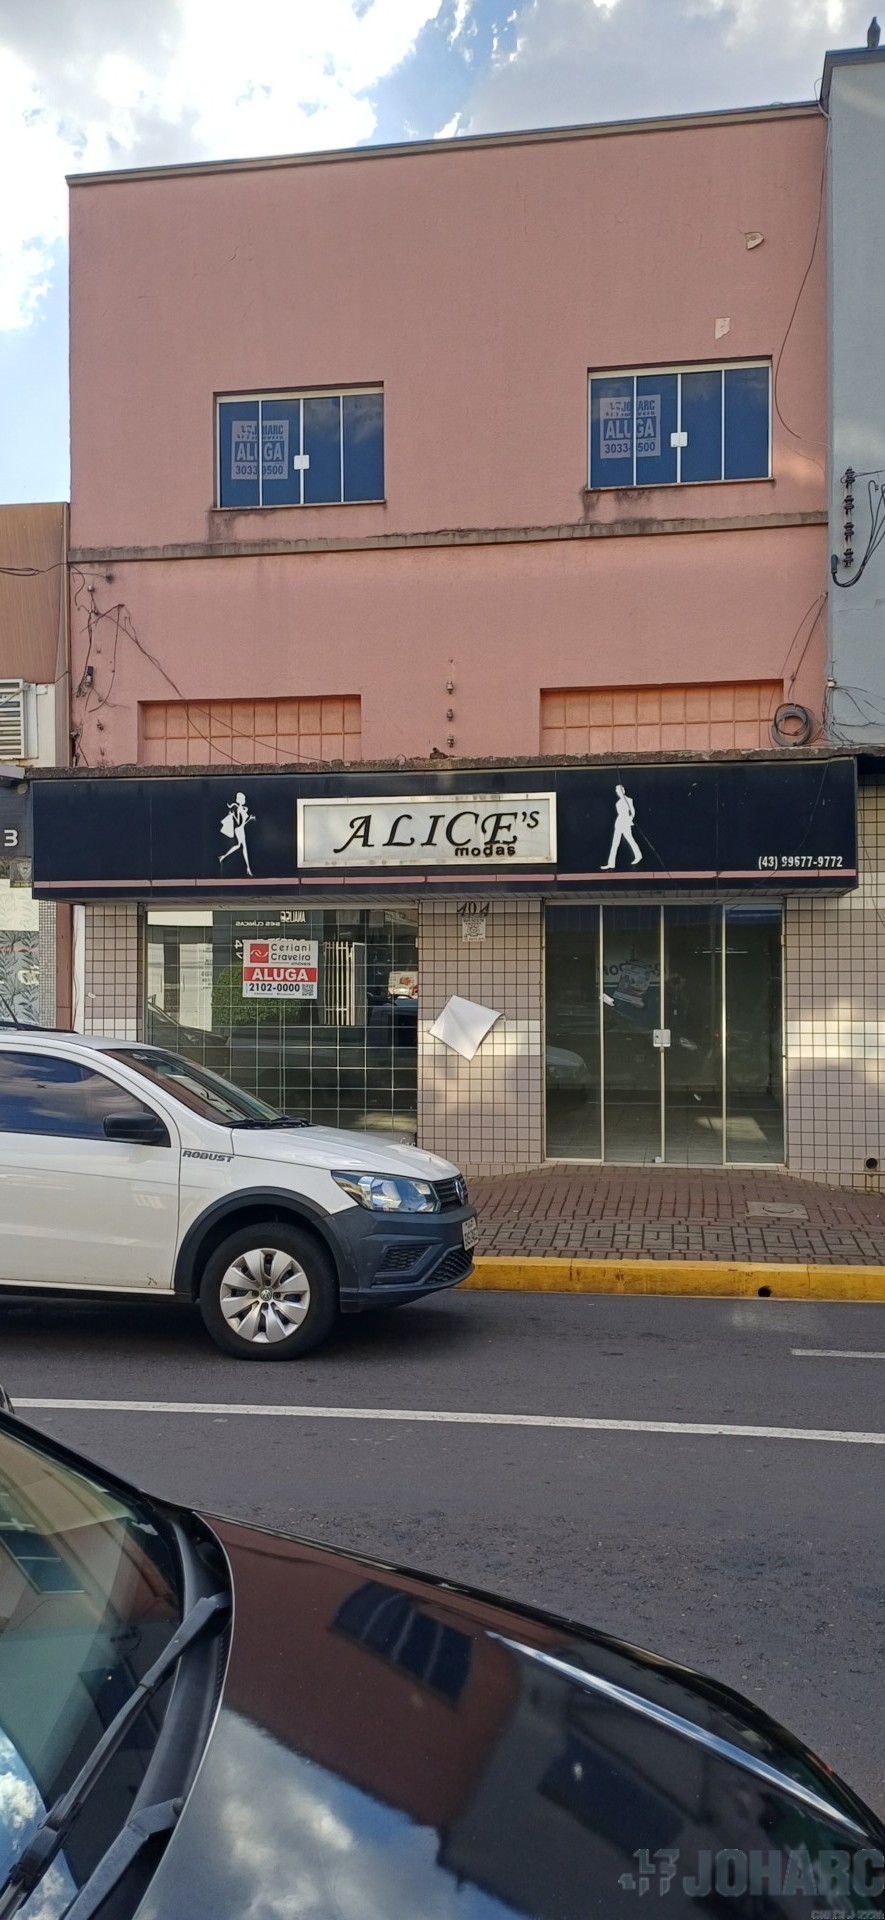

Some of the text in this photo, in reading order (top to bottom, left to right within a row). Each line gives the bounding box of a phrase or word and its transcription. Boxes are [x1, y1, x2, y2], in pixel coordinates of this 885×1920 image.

[622, 400, 655, 411] JOARC
[605, 418, 655, 438] ALUGA
[605, 442, 655, 453] 3033-500
[235, 464, 283, 475] 30330500
[455, 843, 516, 857] modas
[758, 856, 843, 870] (43) 99677-9772
[271, 943, 311, 952] Ceriani
[271, 953, 311, 961] Craveiro
[251, 968, 309, 981] ALUGA
[249, 983, 301, 992] 2102-0000
[183, 1150, 234, 1162] ROBUST
